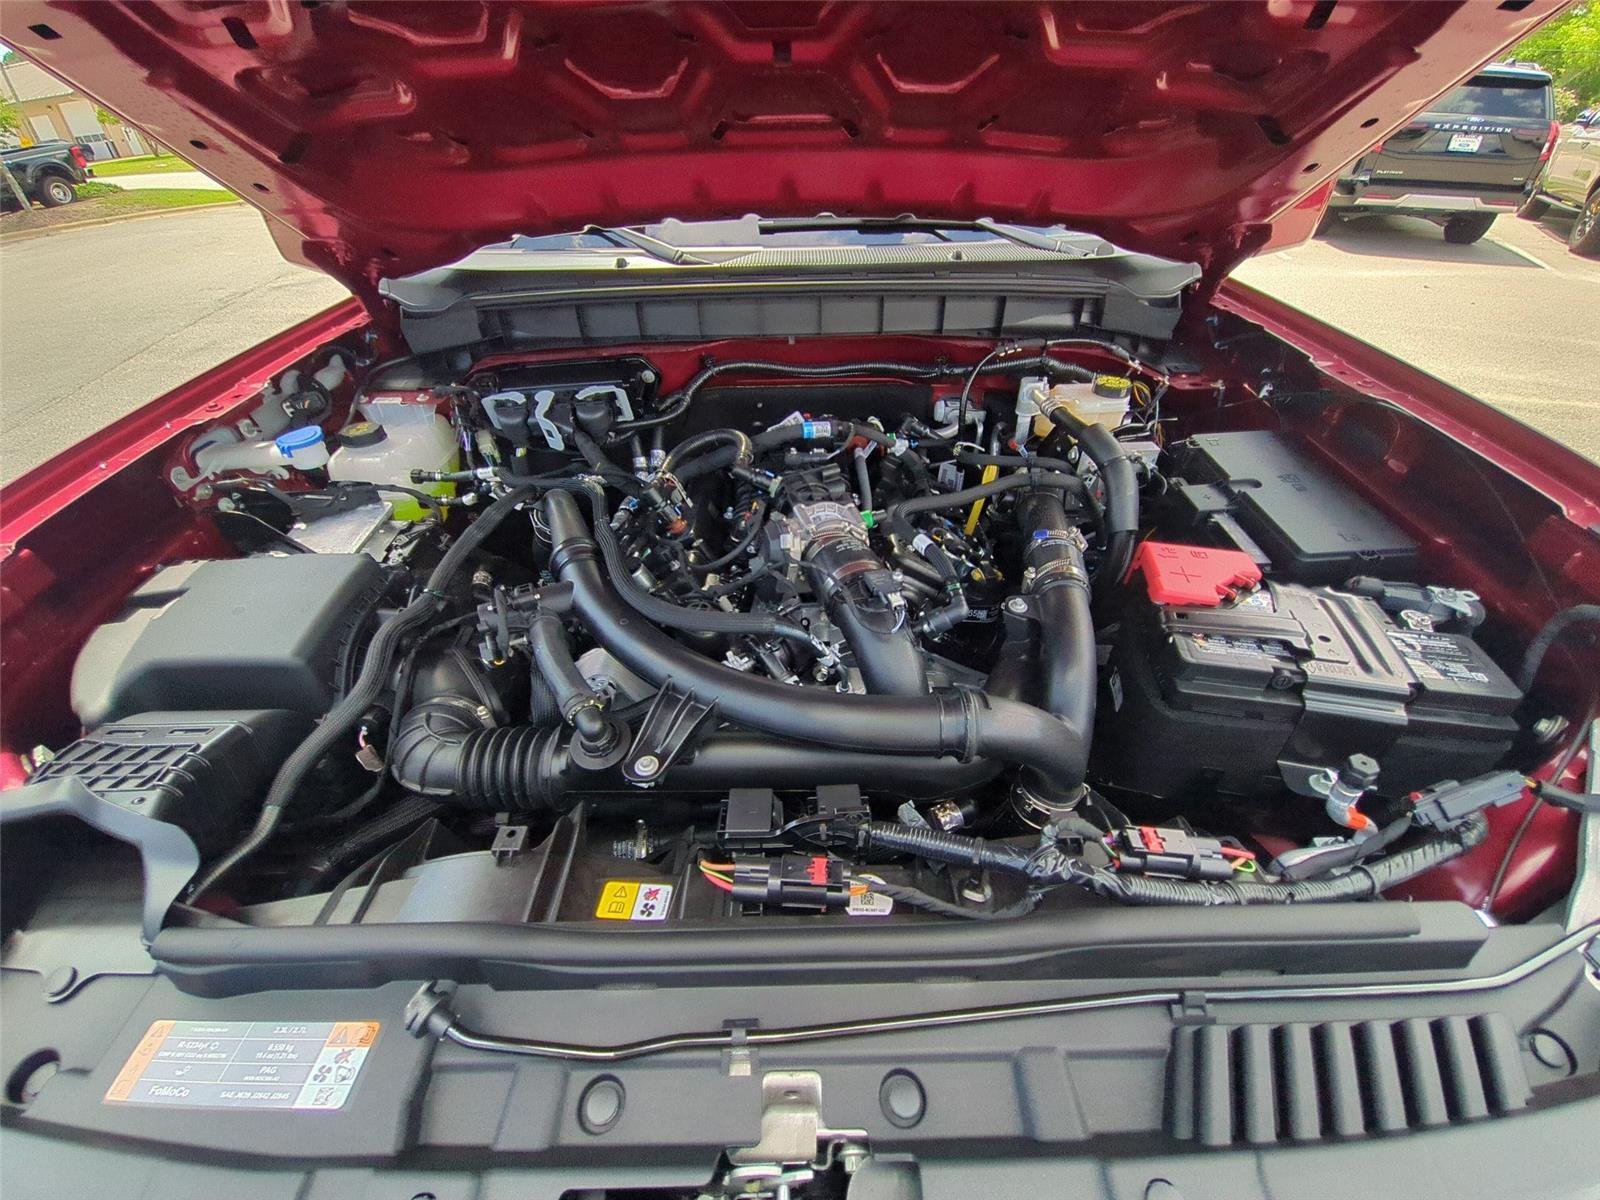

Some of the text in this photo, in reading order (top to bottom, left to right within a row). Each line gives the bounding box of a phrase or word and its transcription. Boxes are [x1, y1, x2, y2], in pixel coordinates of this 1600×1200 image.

[1434, 123, 1512, 133] EXPEDITION
[260, 1066, 277, 1074] PAG
[149, 1085, 190, 1097] FoMoCo
